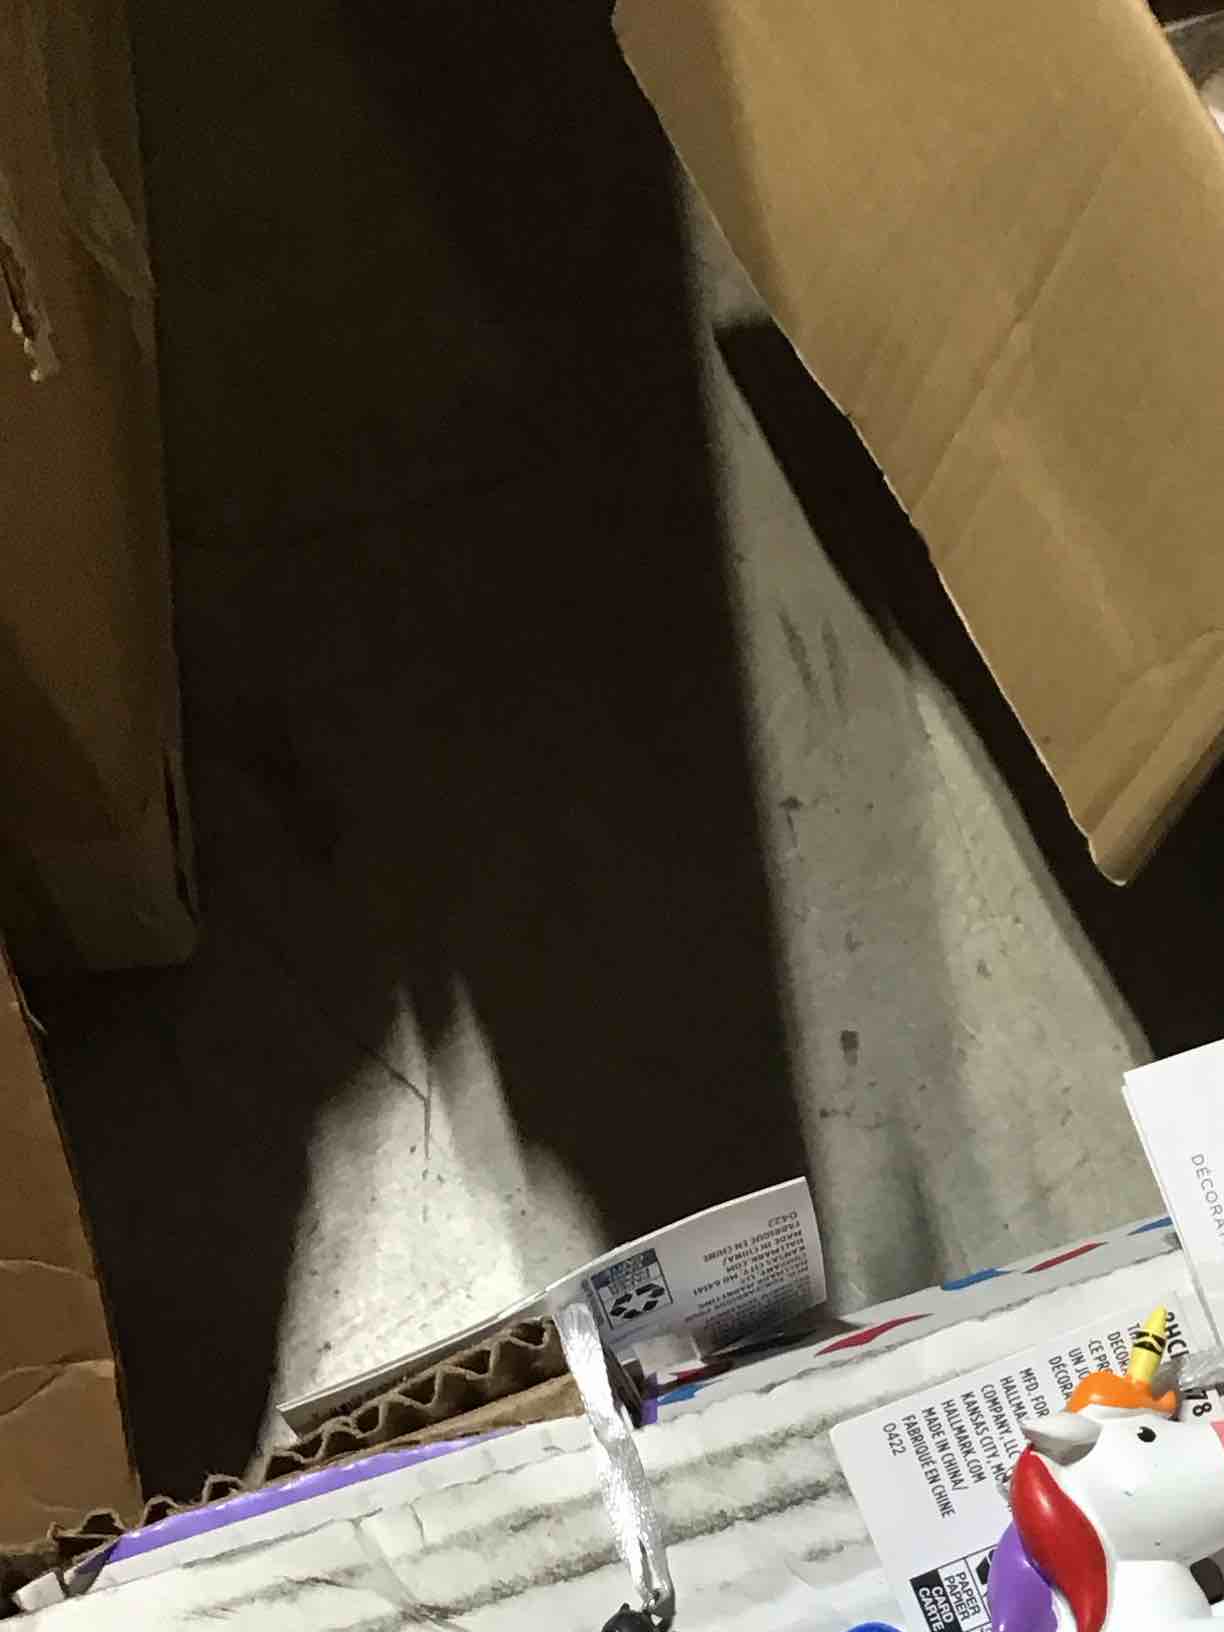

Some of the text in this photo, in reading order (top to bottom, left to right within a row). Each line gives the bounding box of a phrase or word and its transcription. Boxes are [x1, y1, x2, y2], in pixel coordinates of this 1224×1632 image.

[1069, 1348, 1085, 1365] UN
[1000, 1376, 1027, 1423] HALLMA
[1020, 1368, 1049, 1417] MFD. FOR
[883, 1423, 906, 1456] 0422
[942, 1400, 985, 1483] HALLMARK.COM
[961, 1392, 989, 1435] KANSAS
[980, 1436, 1000, 1463] CITY,
[981, 1385, 1021, 1458] COMPANY, LLC
[922, 1407, 968, 1490] MADE IN CHINA/
[925, 1469, 939, 1484] EN
[932, 1485, 955, 1518] CHINE
[932, 1587, 953, 1625] CARD
[945, 1575, 970, 1624] PAPIER
[956, 1572, 980, 1618] PAPER
